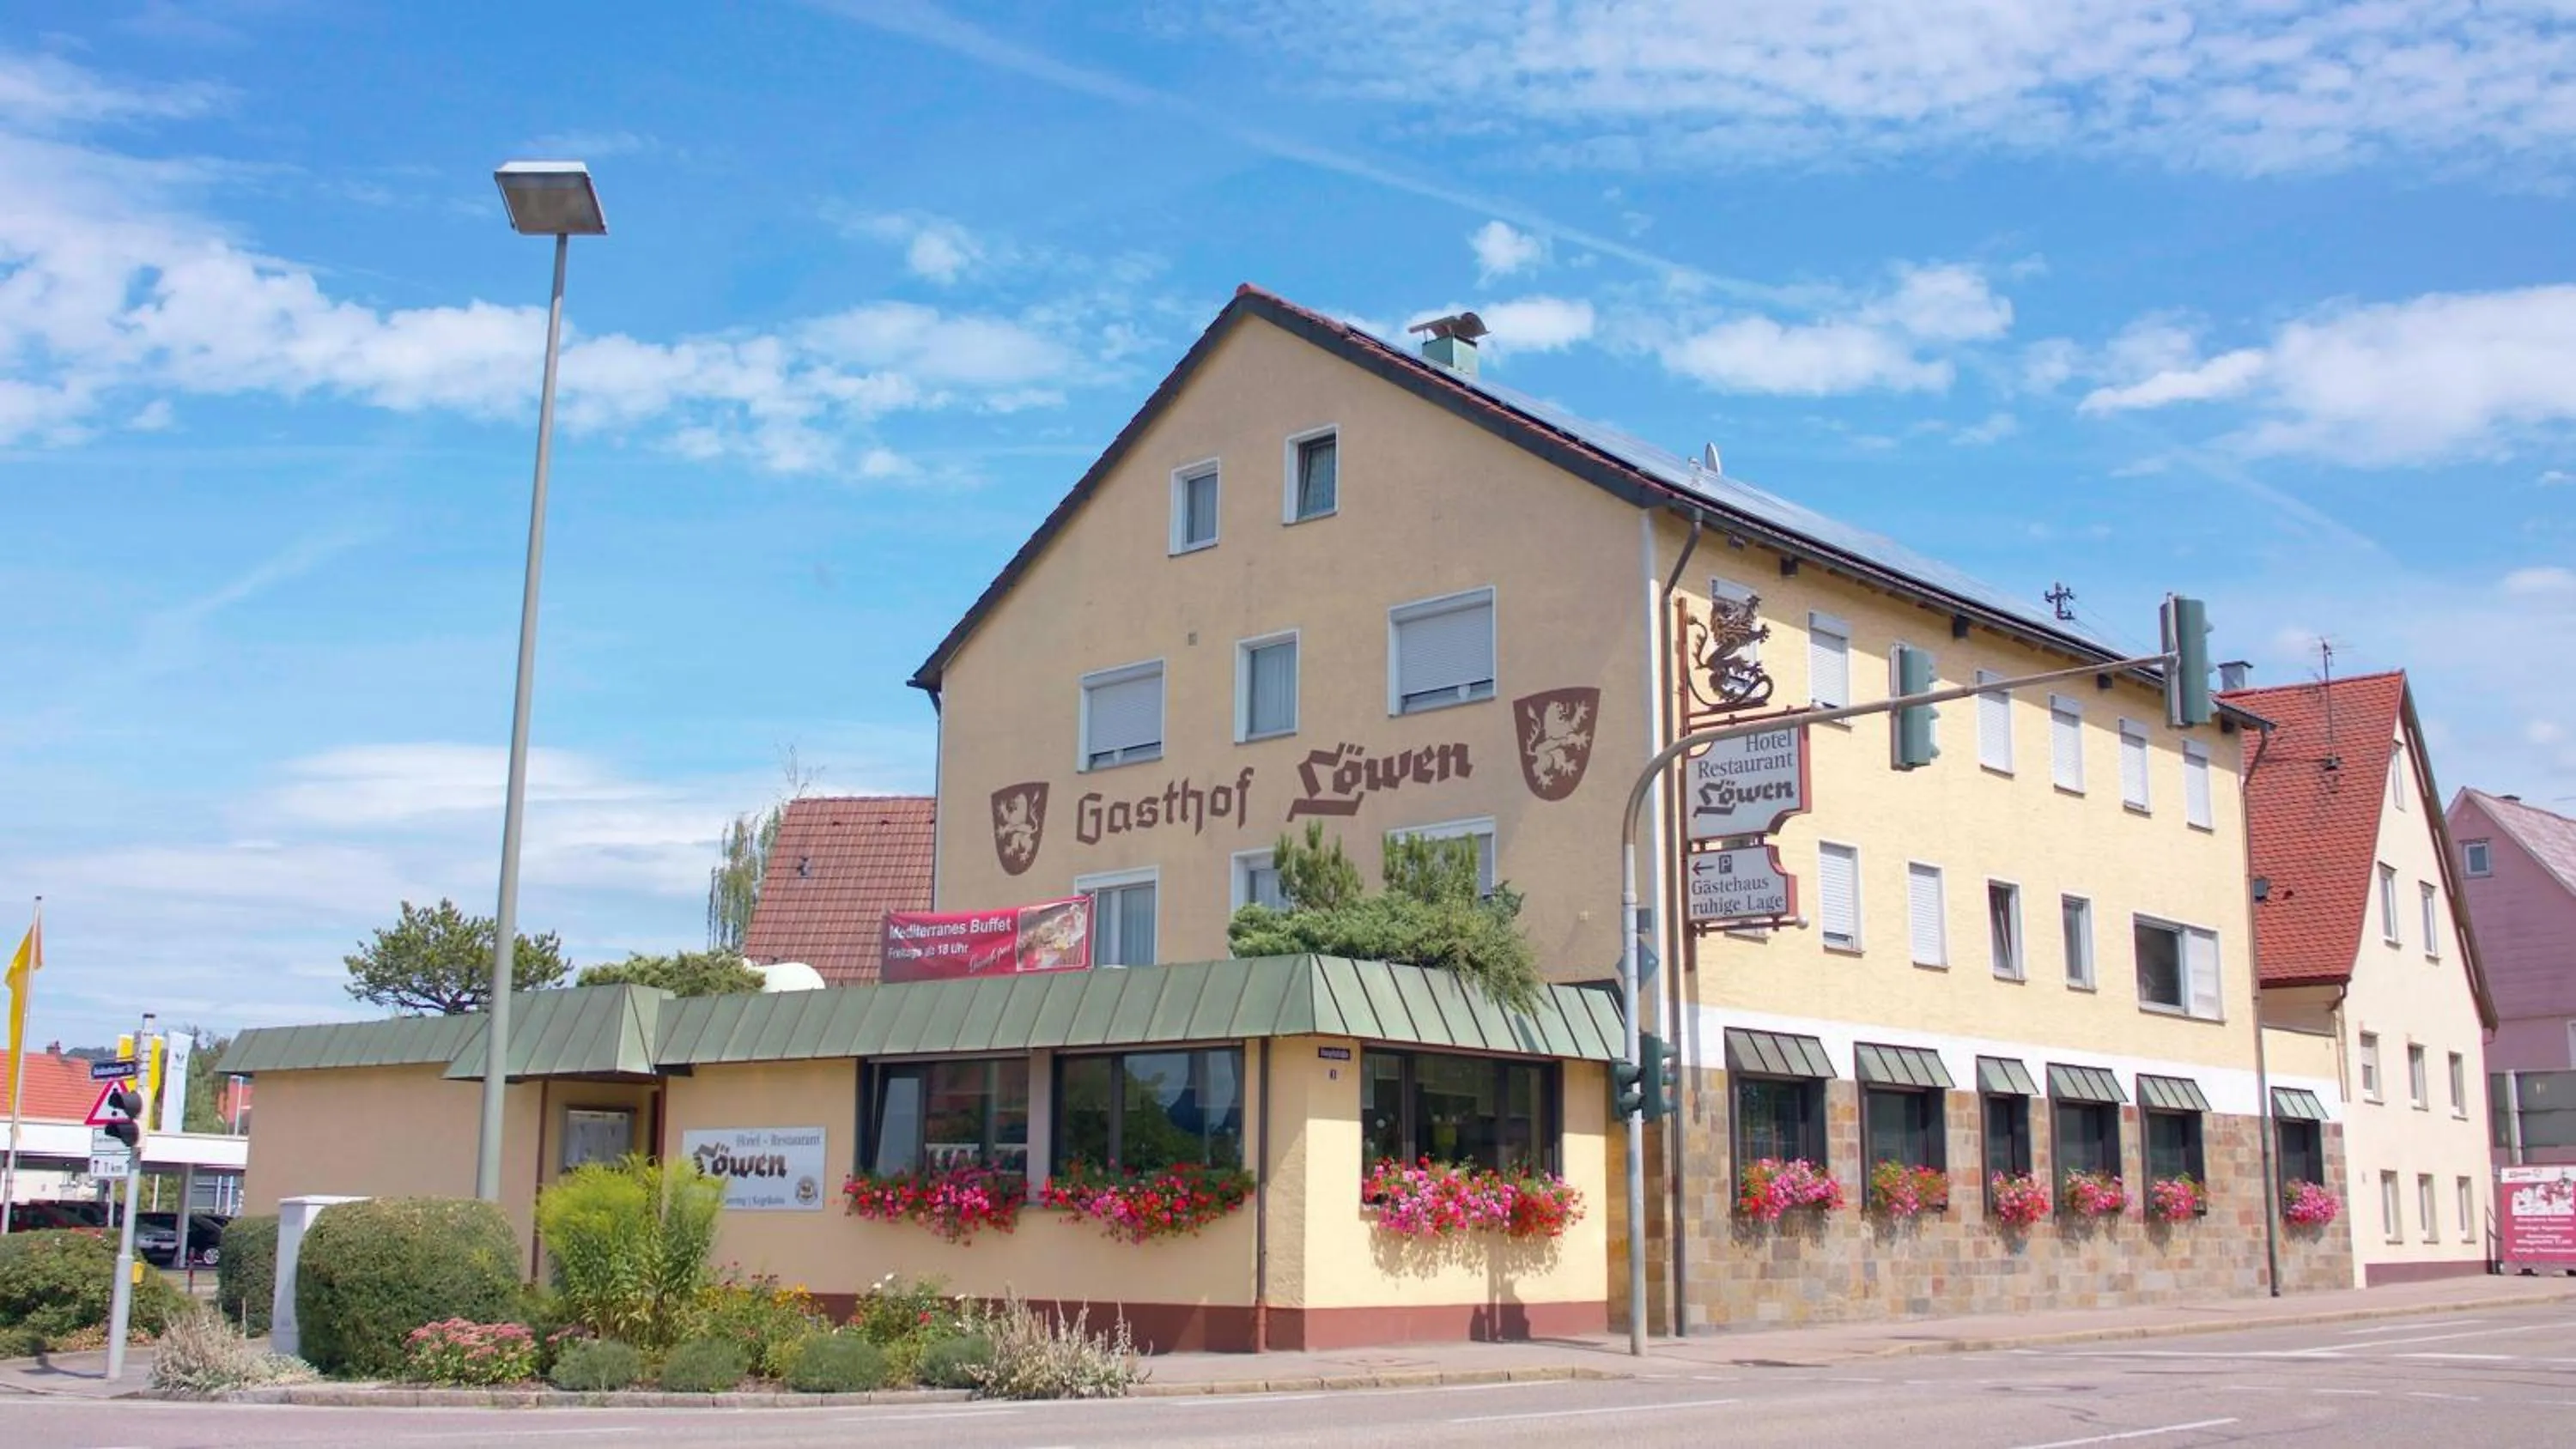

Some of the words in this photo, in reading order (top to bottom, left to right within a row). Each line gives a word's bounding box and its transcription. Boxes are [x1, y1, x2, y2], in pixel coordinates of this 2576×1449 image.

[1746, 729, 1792, 752] Hotel
[1697, 752, 1794, 779] Restaurant
[1076, 767, 1255, 846] Gasthof
[1286, 742, 1474, 822] Löwen
[1693, 779, 1795, 818] Löwen
[1692, 876, 1770, 895] Gästehaus
[1692, 899, 1741, 916] ruhige
[1747, 894, 1783, 911] Lage
[969, 916, 1012, 934] Buffet
[951, 942, 969, 955] Uhr
[736, 1133, 761, 1147] Hotel
[770, 1133, 820, 1146] Restaurant
